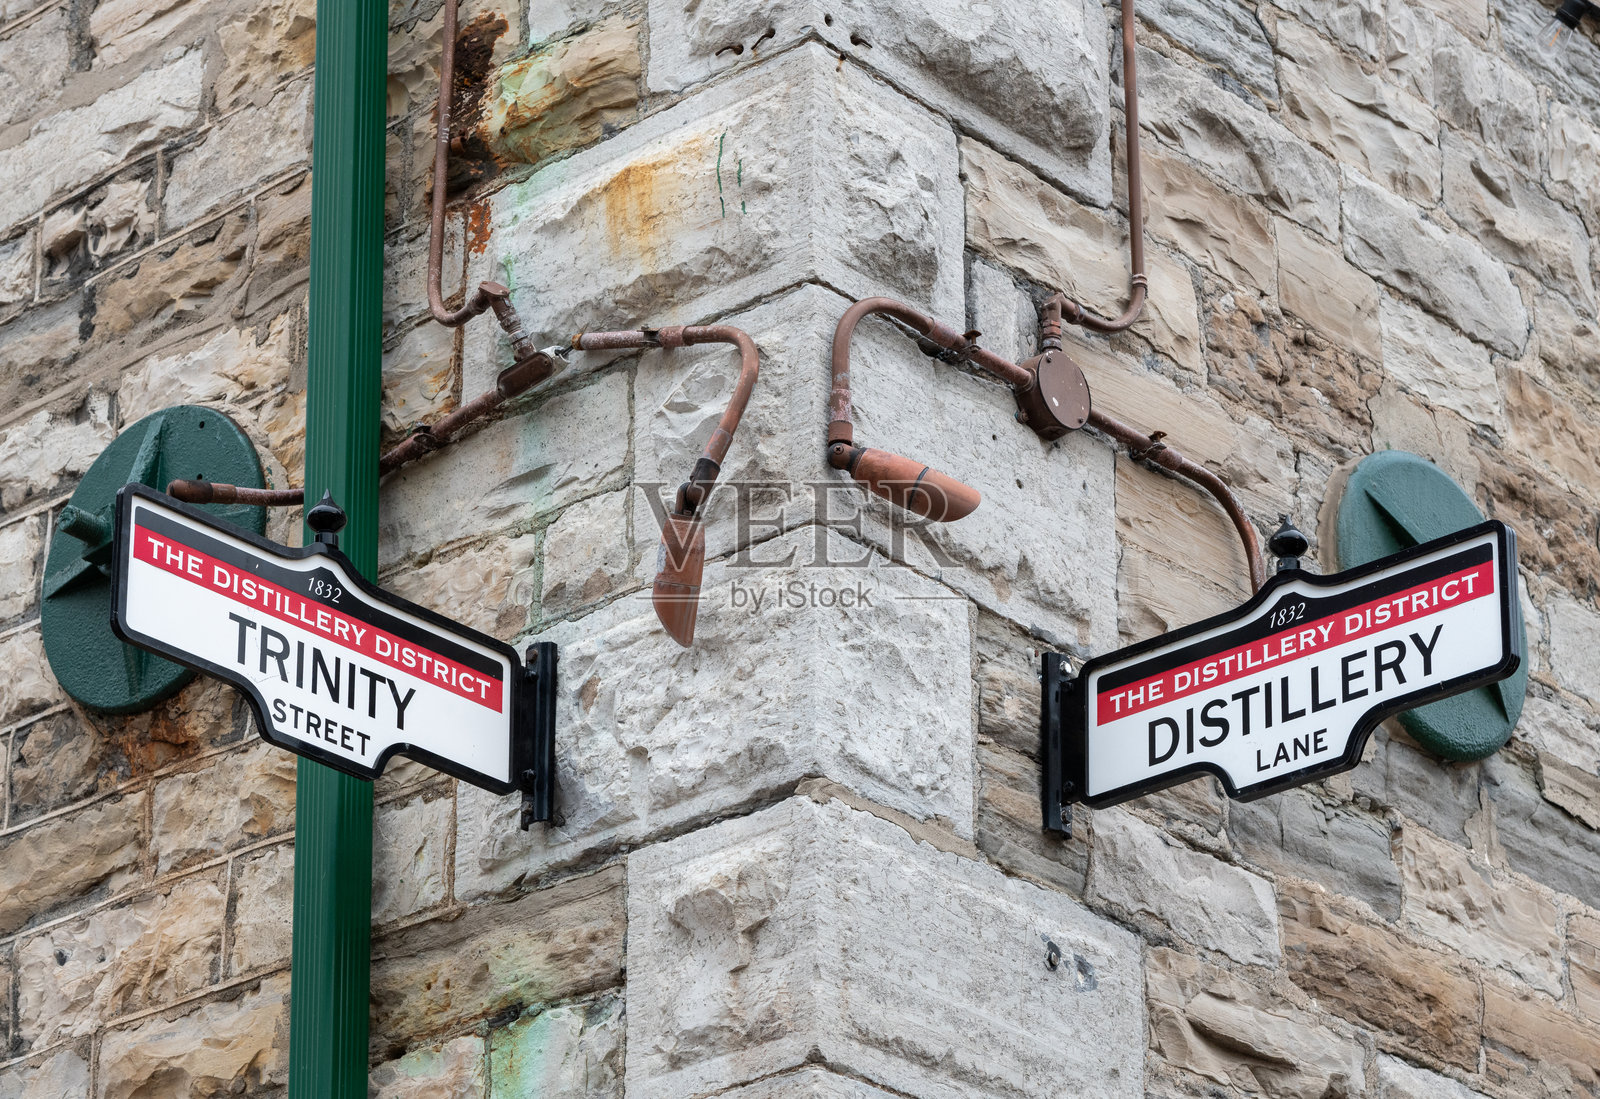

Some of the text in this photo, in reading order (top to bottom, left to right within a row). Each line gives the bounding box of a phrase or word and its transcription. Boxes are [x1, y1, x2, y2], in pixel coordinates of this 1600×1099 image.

[147, 536, 491, 699] THE DISTILLERY DISTRICT
[307, 576, 342, 604] 1832
[1269, 602, 1306, 629] 1832
[228, 612, 416, 730] TRINITY
[1109, 571, 1480, 713] THE DISTILLERY DISTRICT
[272, 698, 371, 757] STREET
[1148, 624, 1444, 767] DISTILLERY
[1256, 728, 1328, 772] LANE
